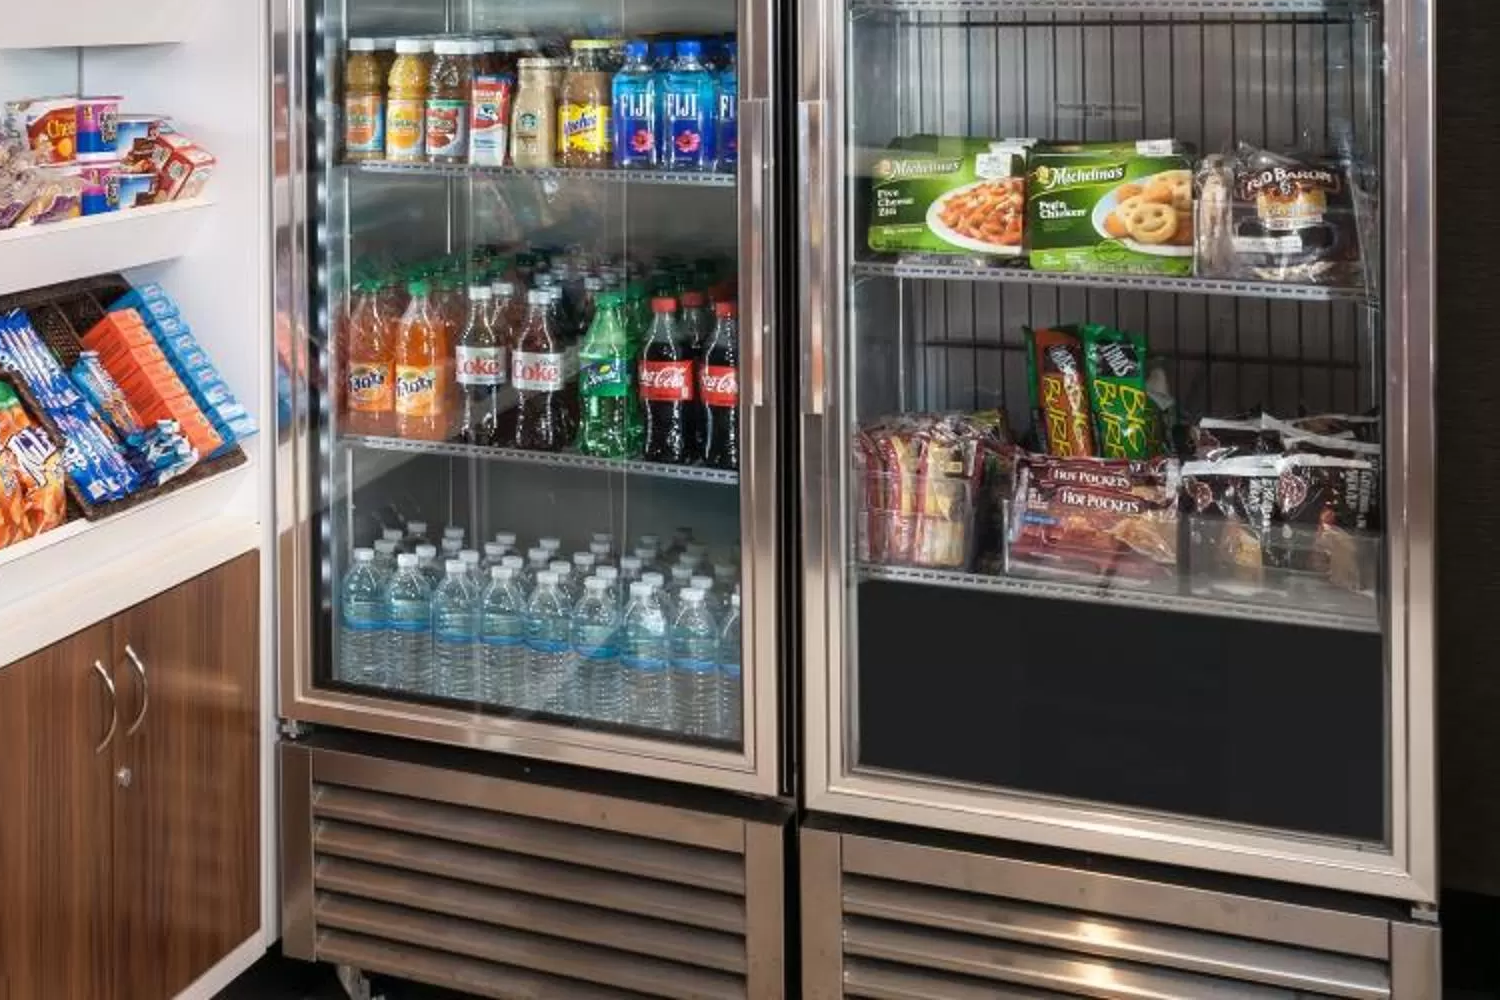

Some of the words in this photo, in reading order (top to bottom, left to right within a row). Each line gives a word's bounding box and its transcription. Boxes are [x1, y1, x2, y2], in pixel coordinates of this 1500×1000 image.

[667, 93, 698, 117] FIJI
[721, 94, 735, 118] FI
[1048, 165, 1124, 189] Michelina's
[512, 359, 560, 382] Coke
[1061, 491, 1086, 506] HOT
[1088, 495, 1140, 514] POCKETS
